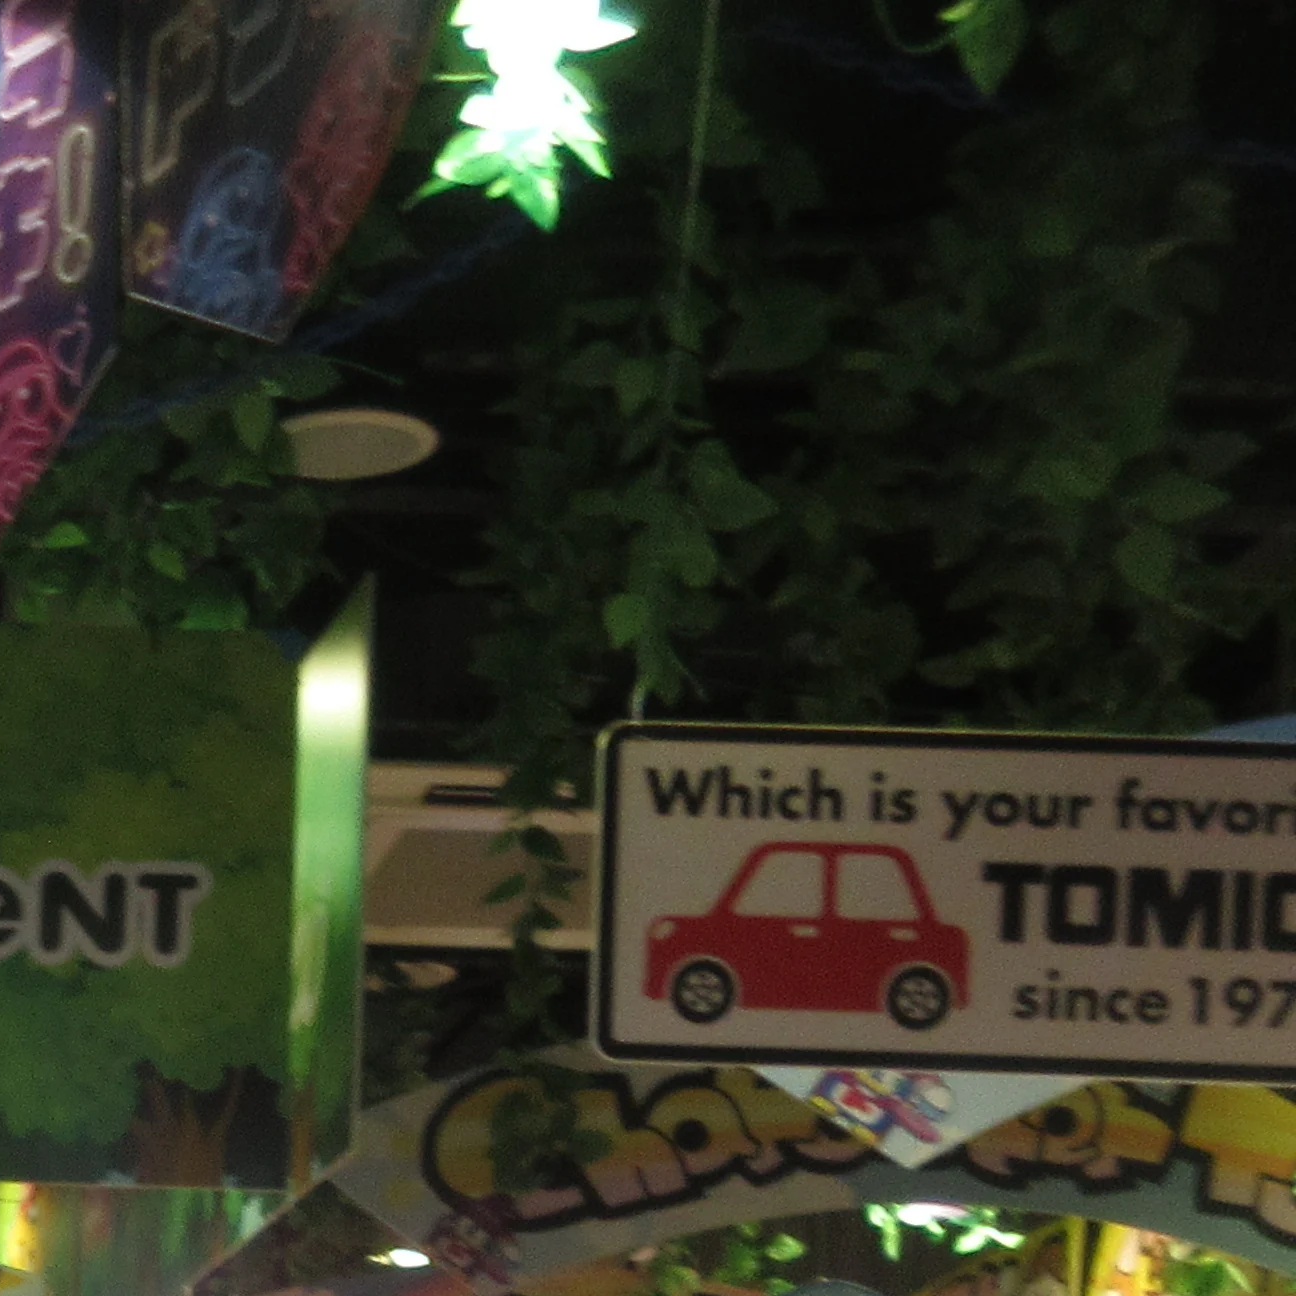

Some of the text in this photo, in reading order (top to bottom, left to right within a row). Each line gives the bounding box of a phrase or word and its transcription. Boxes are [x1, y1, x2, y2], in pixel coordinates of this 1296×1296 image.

[644, 767, 1296, 841] Which is your favor
[1013, 967, 1171, 1025] since
